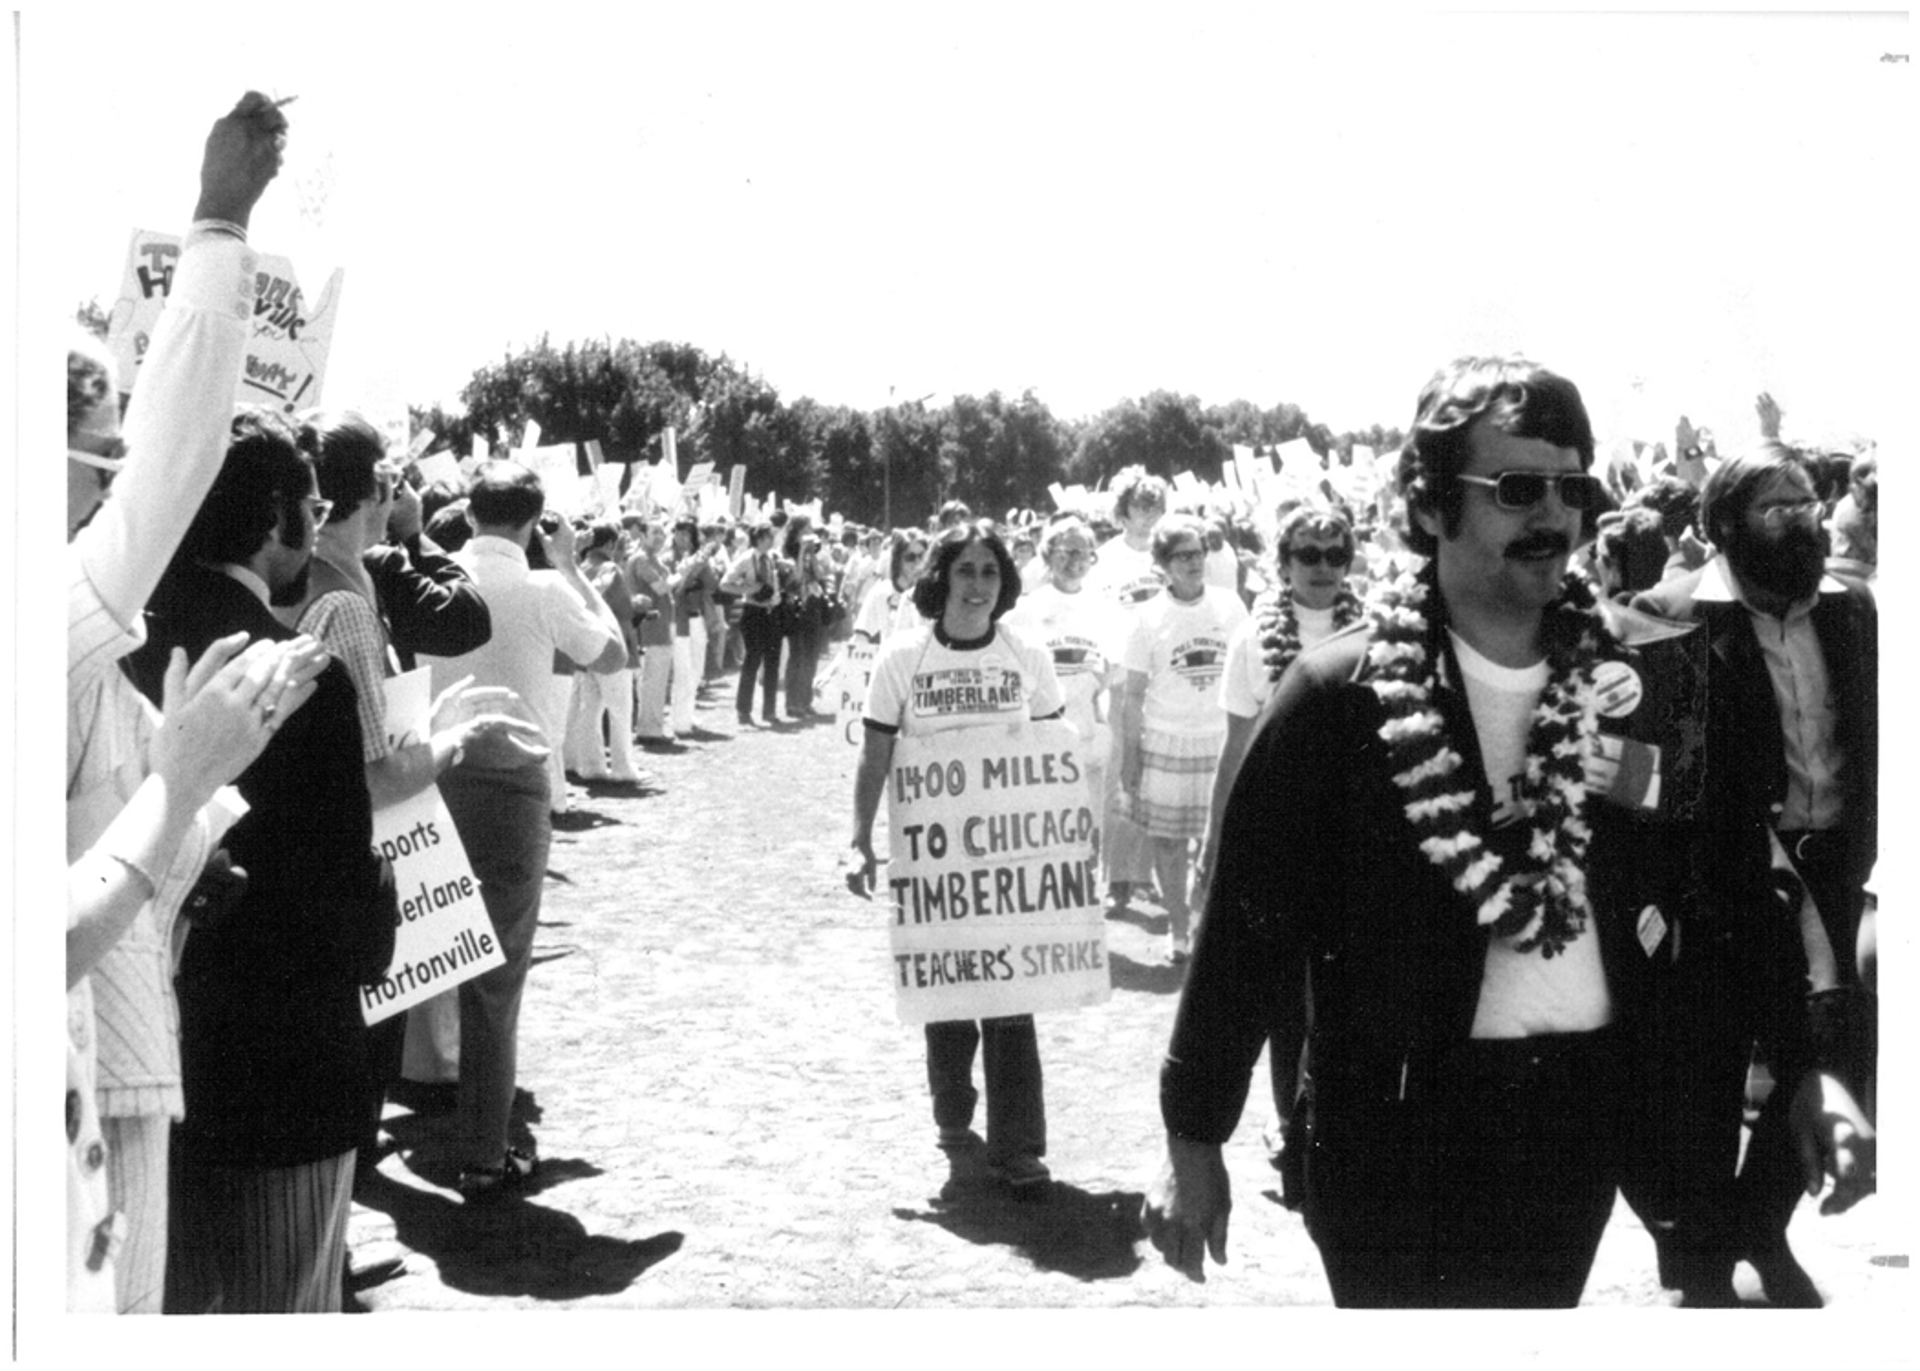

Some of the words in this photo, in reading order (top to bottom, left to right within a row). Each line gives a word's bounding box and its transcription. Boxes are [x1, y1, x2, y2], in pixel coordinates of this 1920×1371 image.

[914, 687, 1021, 709] TIMBERLANE
[896, 759, 967, 804] 1,400
[982, 751, 1080, 790] MILES
[903, 822, 948, 861] TO
[962, 806, 1100, 858] CHICAGO,
[889, 860, 1101, 926] TIMBERLANE
[363, 928, 495, 1010] Hortonville
[894, 944, 1015, 988] TEACHERS'
[1020, 940, 1104, 978] STRIKE
